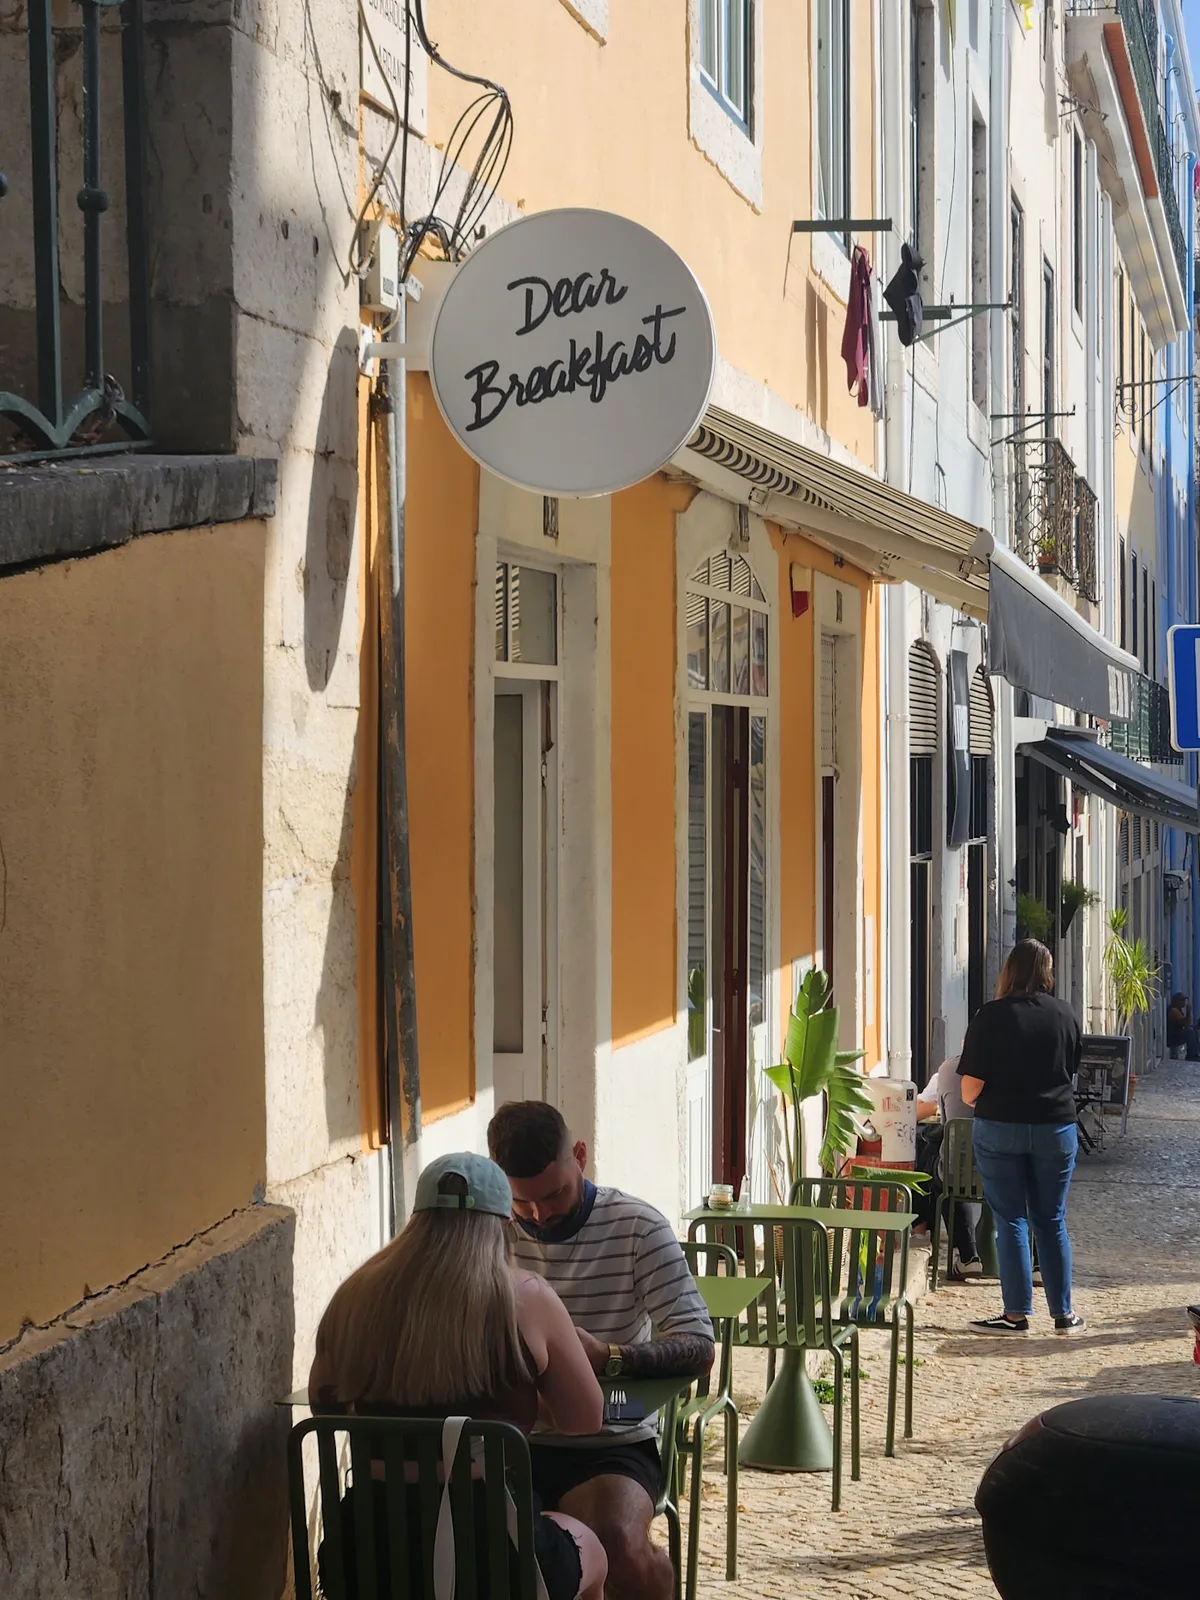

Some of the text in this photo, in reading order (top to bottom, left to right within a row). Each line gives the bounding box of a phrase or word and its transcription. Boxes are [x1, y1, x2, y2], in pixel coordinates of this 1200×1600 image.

[379, 0, 408, 36] MARQUE
[378, 44, 414, 97] ABRANTS
[507, 268, 629, 336] Dear
[464, 304, 687, 432] Breakfast
